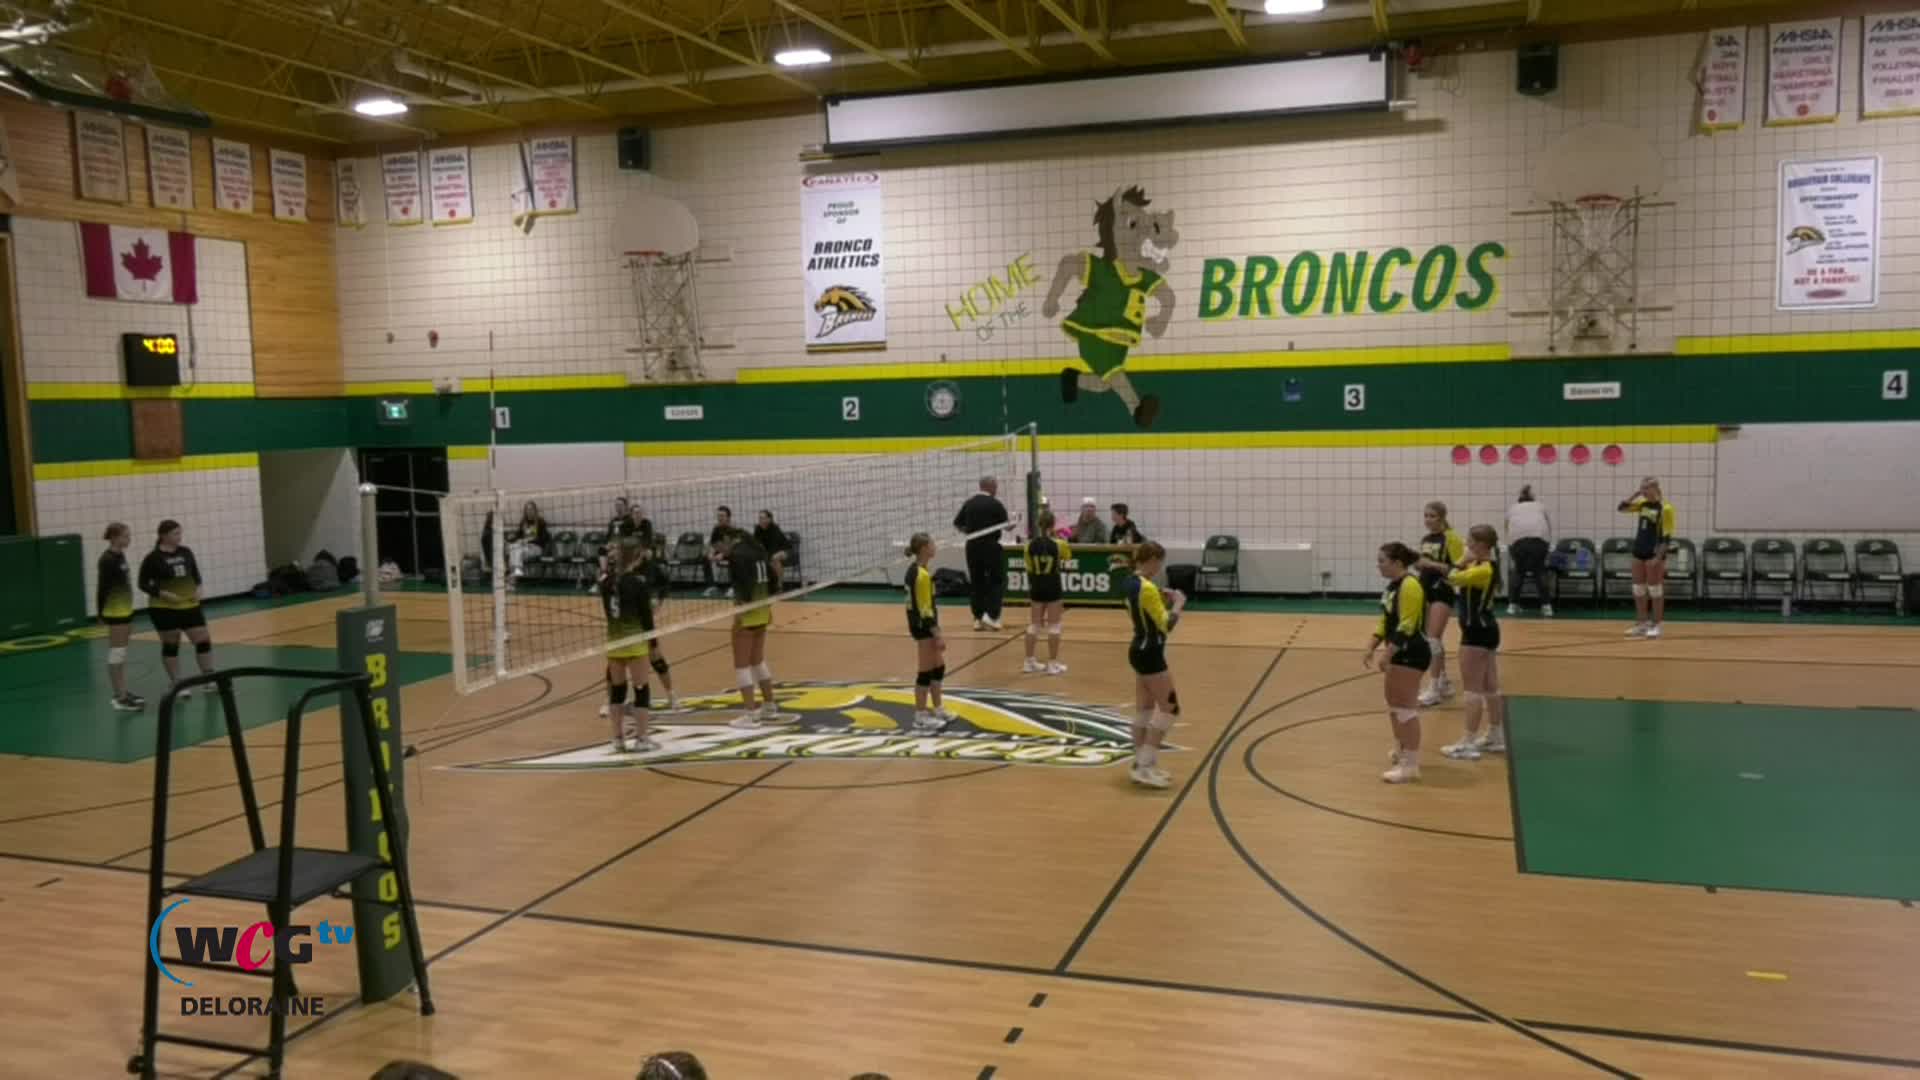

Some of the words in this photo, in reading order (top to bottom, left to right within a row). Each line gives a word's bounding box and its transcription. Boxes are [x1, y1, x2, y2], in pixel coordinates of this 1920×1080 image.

[813, 238, 872, 255] BRONCO
[807, 254, 880, 271] ATHLETICS
[945, 250, 1041, 331] HOME
[1198, 241, 1508, 321] BRONCOS
[1887, 374, 1903, 395] 4
[1347, 388, 1360, 407] 3
[499, 410, 508, 426] 1
[845, 400, 857, 418] 2
[755, 560, 769, 583] 11
[1033, 555, 1054, 575] 17
